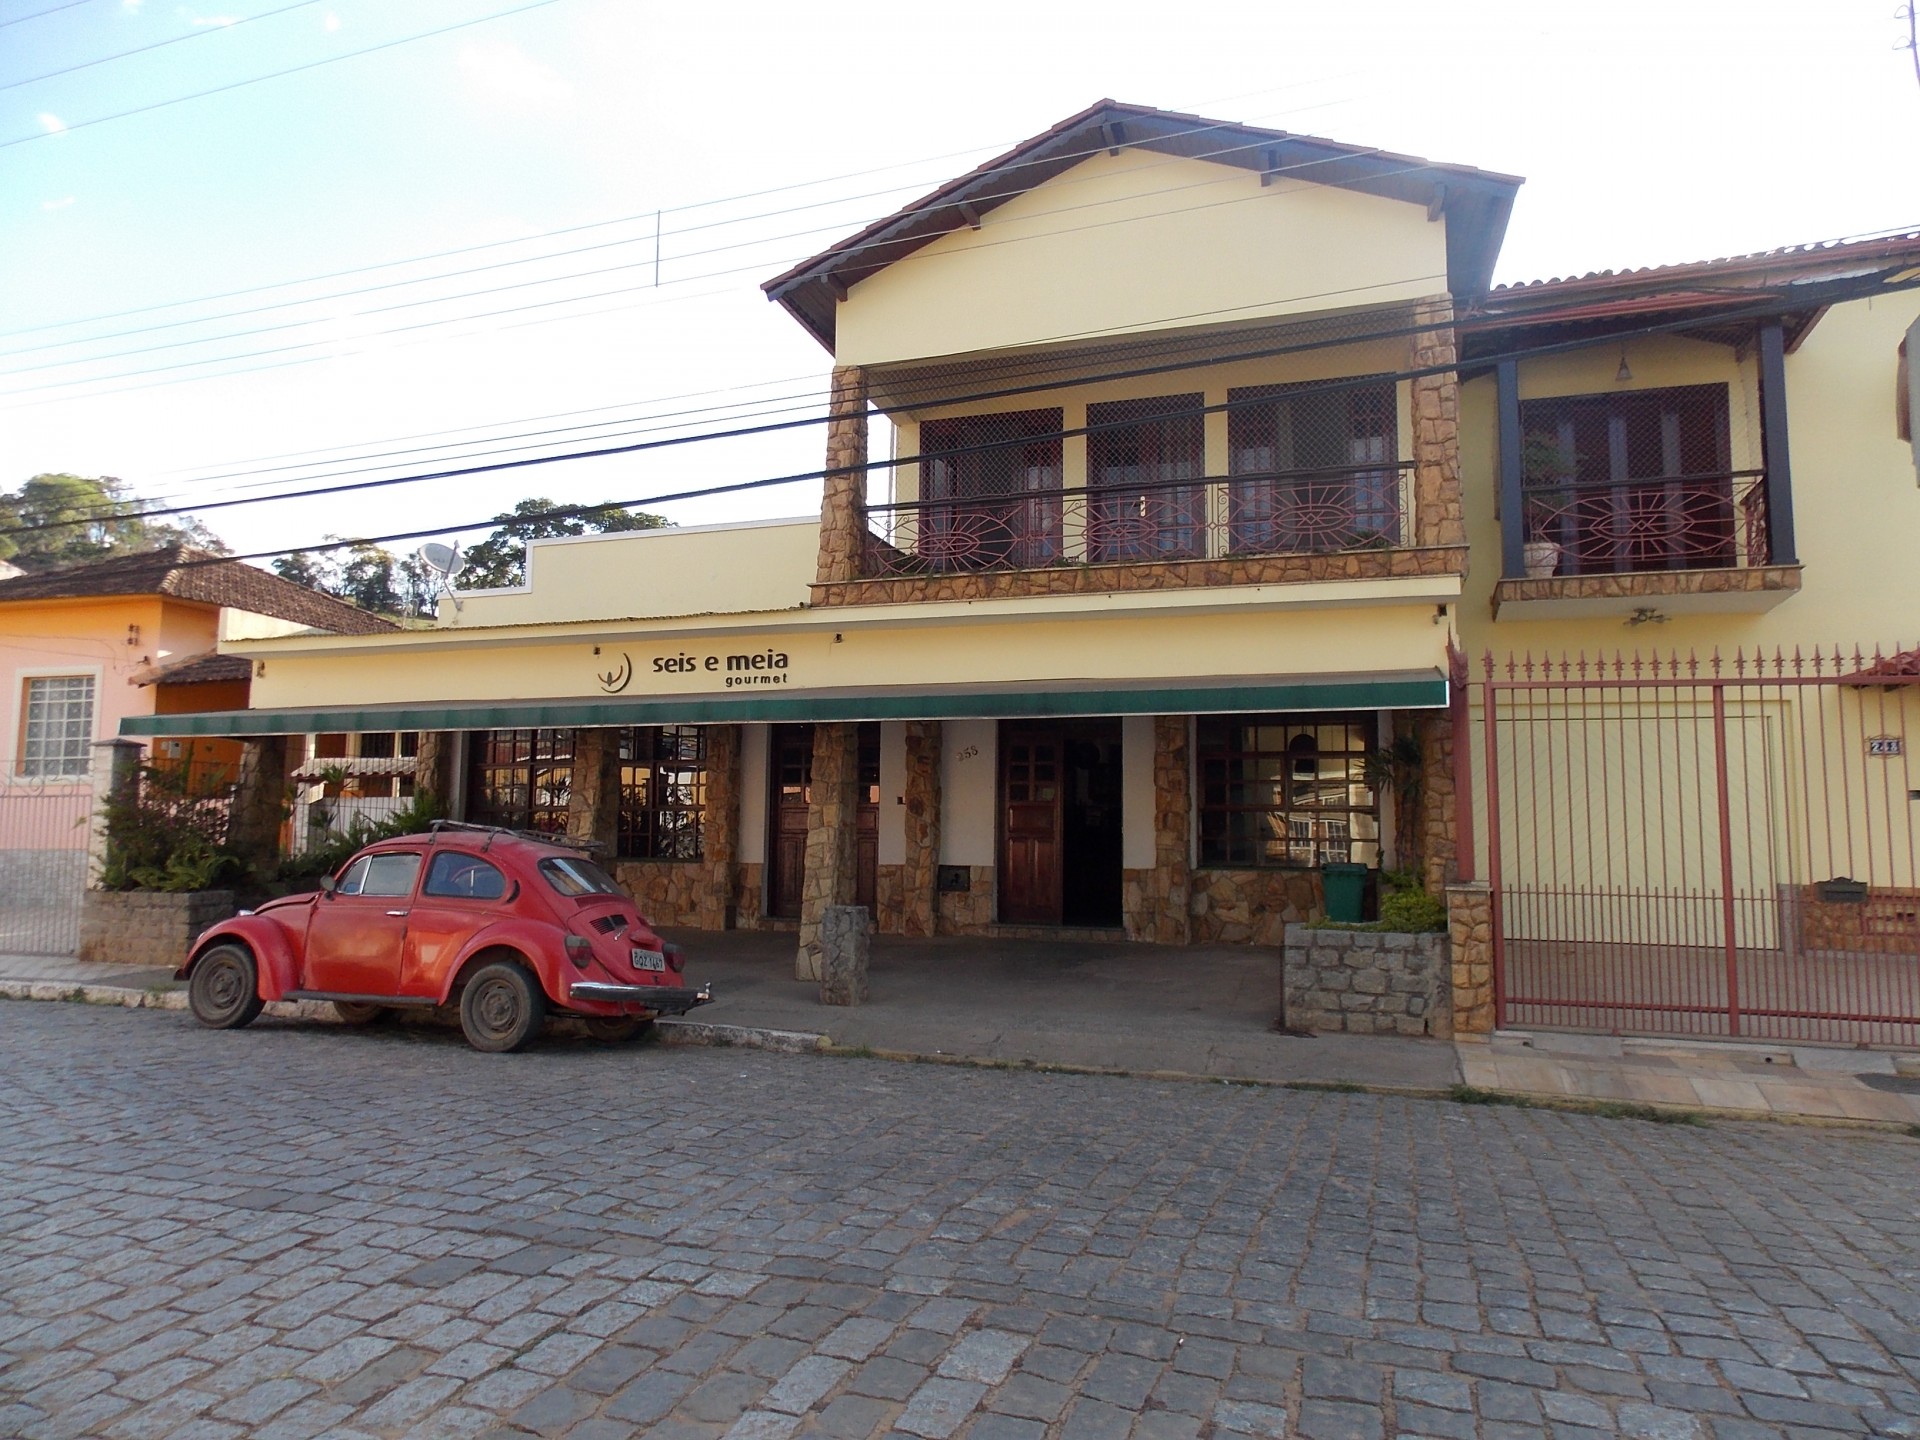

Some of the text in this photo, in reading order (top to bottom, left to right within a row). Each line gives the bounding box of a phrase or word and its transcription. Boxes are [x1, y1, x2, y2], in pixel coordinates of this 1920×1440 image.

[653, 649, 789, 673] seis e meia
[725, 673, 787, 687] gourmet
